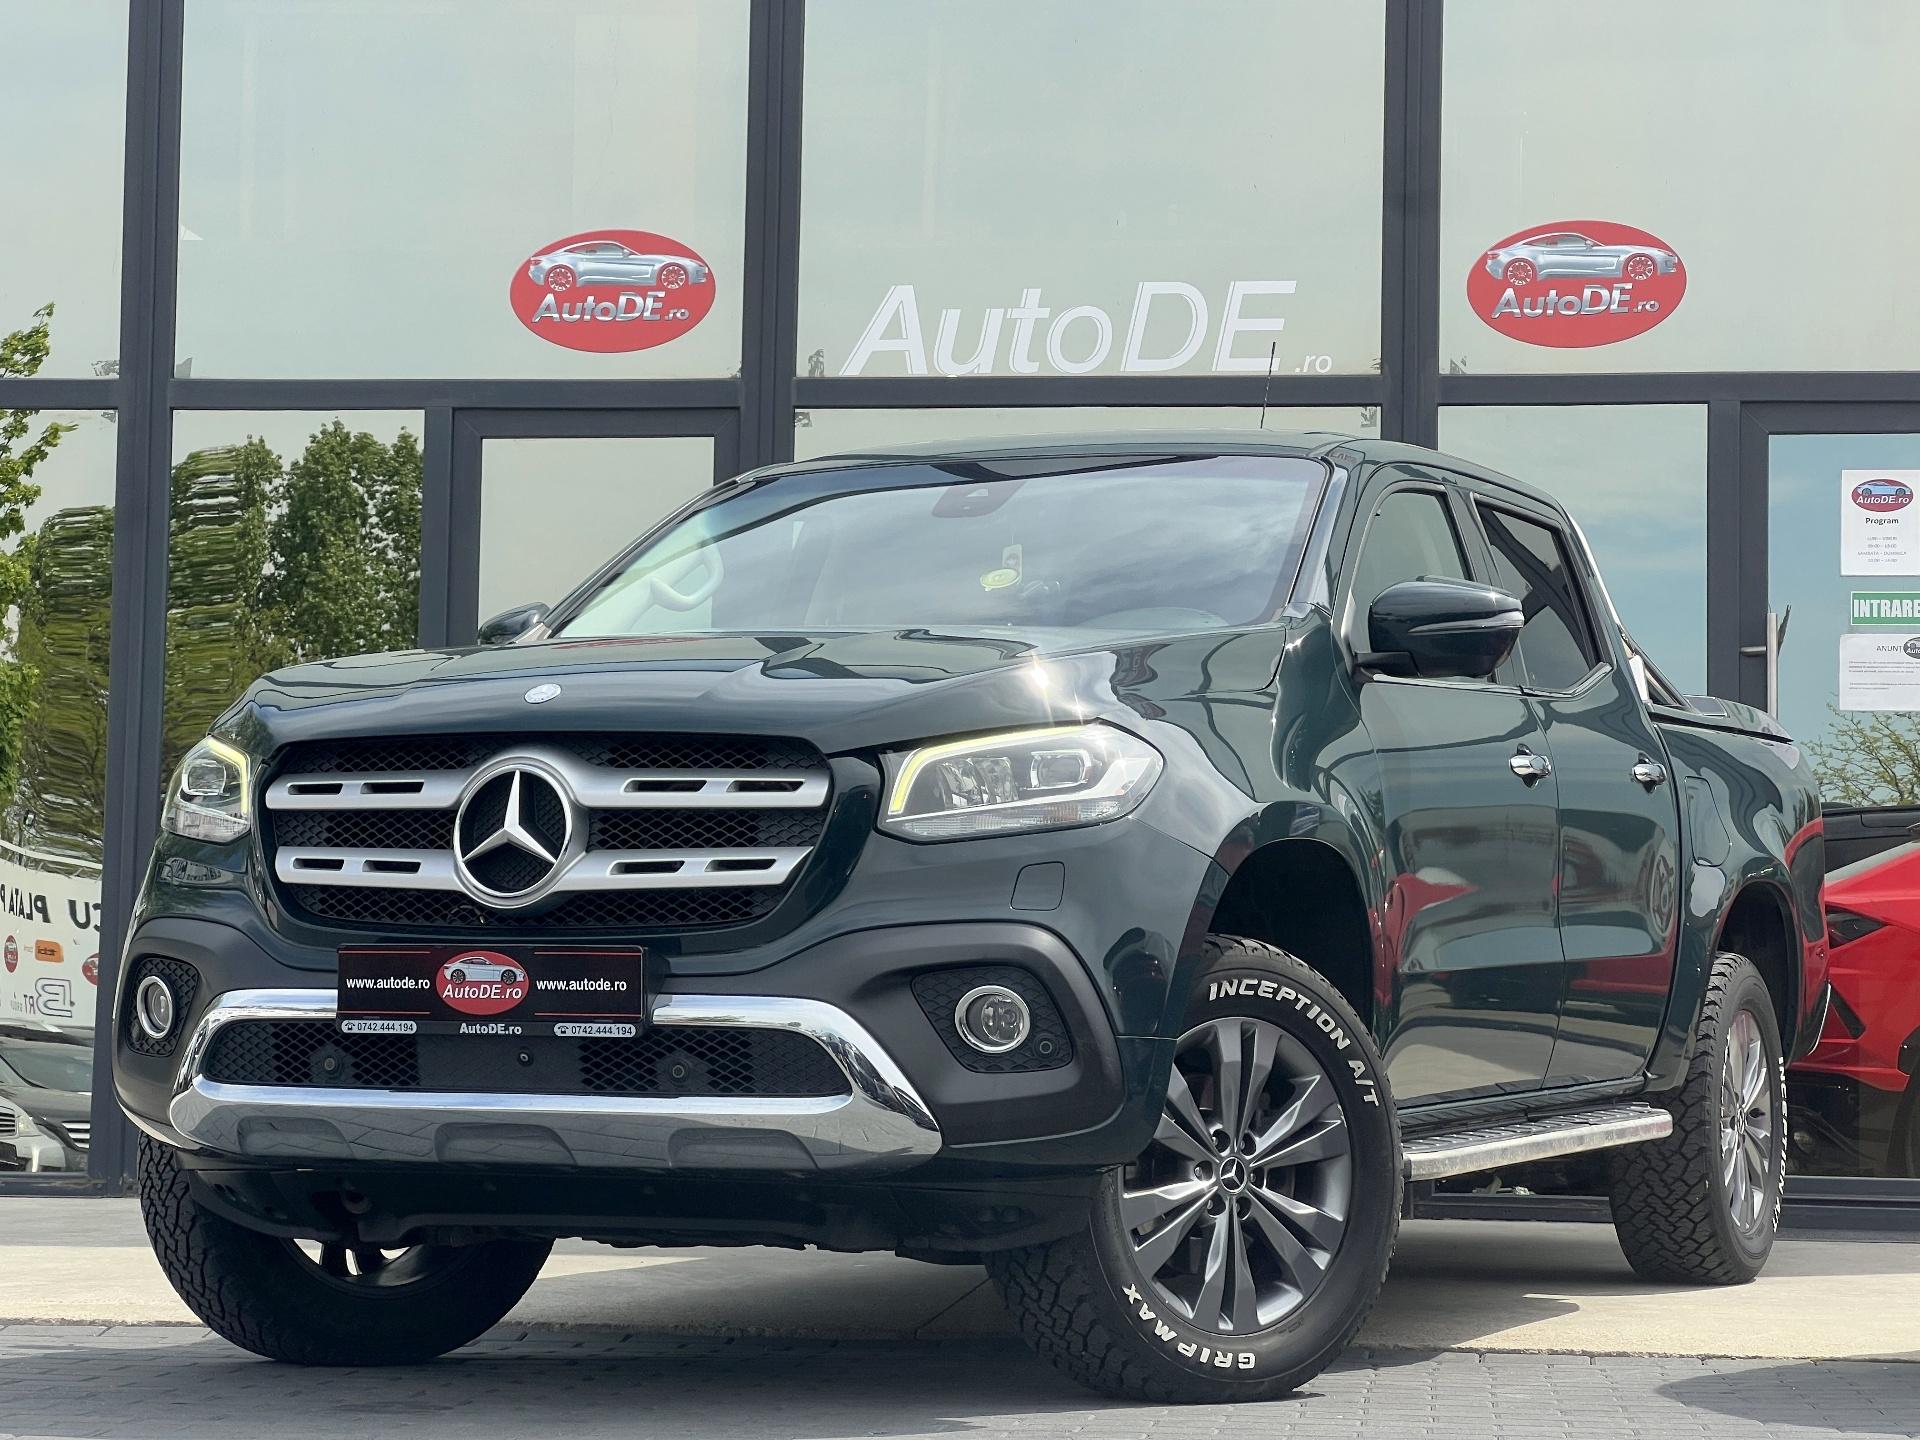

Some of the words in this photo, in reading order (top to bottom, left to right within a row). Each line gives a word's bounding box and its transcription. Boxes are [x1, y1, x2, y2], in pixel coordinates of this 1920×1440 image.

[1856, 495, 1910, 504] AutoDE.ro
[1865, 517, 1899, 525] Program
[1853, 599, 1920, 618] INTRARE
[346, 976, 431, 990] www.autode.ro
[535, 978, 627, 992] www.autode.ro
[442, 983, 522, 999] AutoDE.ro
[356, 1021, 415, 1033] 0742.444.194
[459, 1022, 522, 1036] AutoDE.ro
[570, 1025, 633, 1037] 0742.444.194
[1209, 978, 1351, 1050] INCEPTION
[1348, 1059, 1380, 1108] A/T
[1122, 1283, 1256, 1370] GRIPMAX
